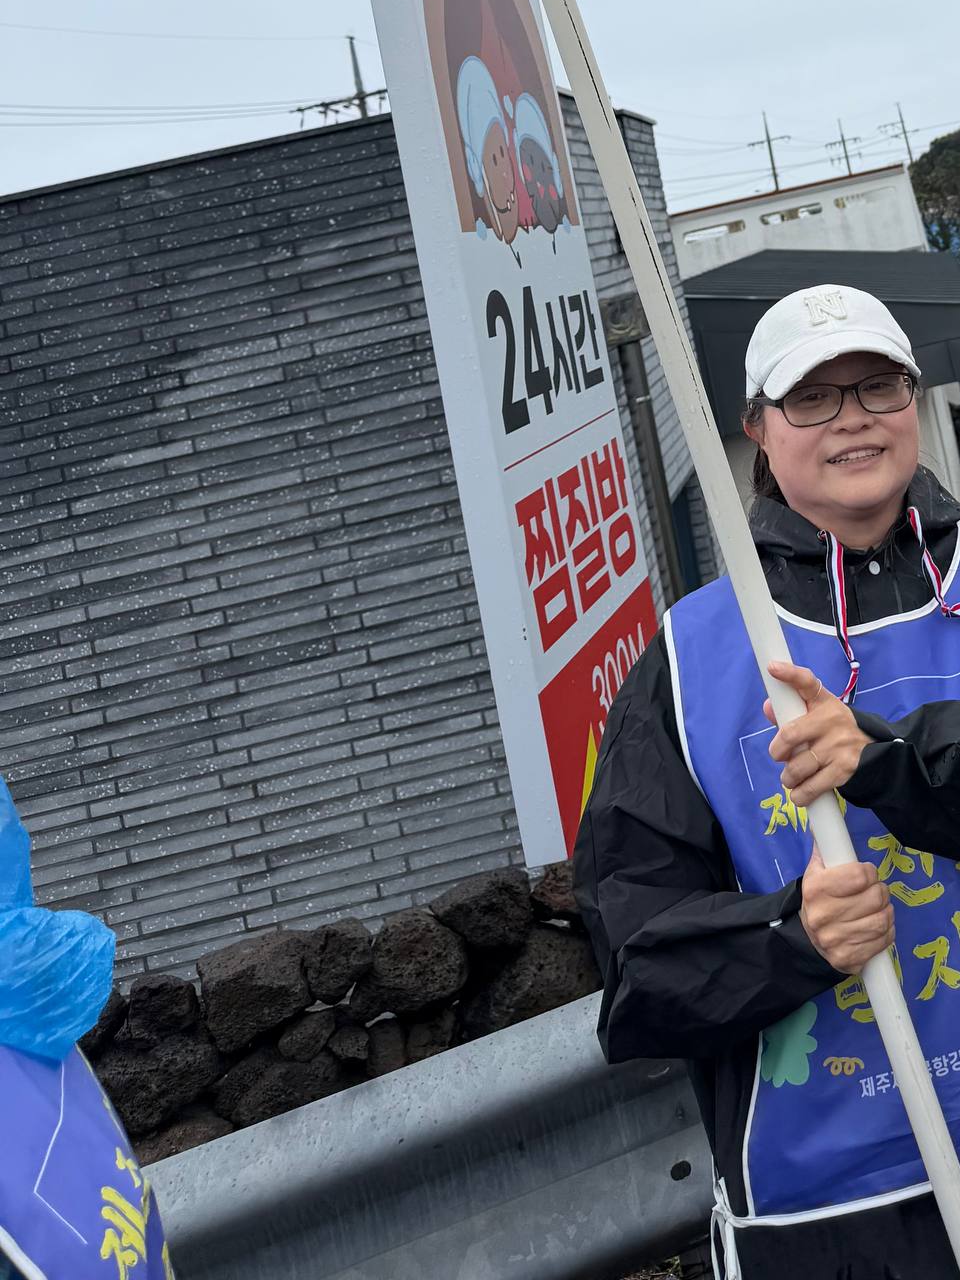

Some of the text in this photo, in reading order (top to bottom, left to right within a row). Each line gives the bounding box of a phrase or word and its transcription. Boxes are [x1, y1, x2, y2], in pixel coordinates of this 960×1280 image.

[485, 285, 605, 435] 24시간
[804, 290, 847, 327] N
[514, 436, 639, 654] 찜질방
